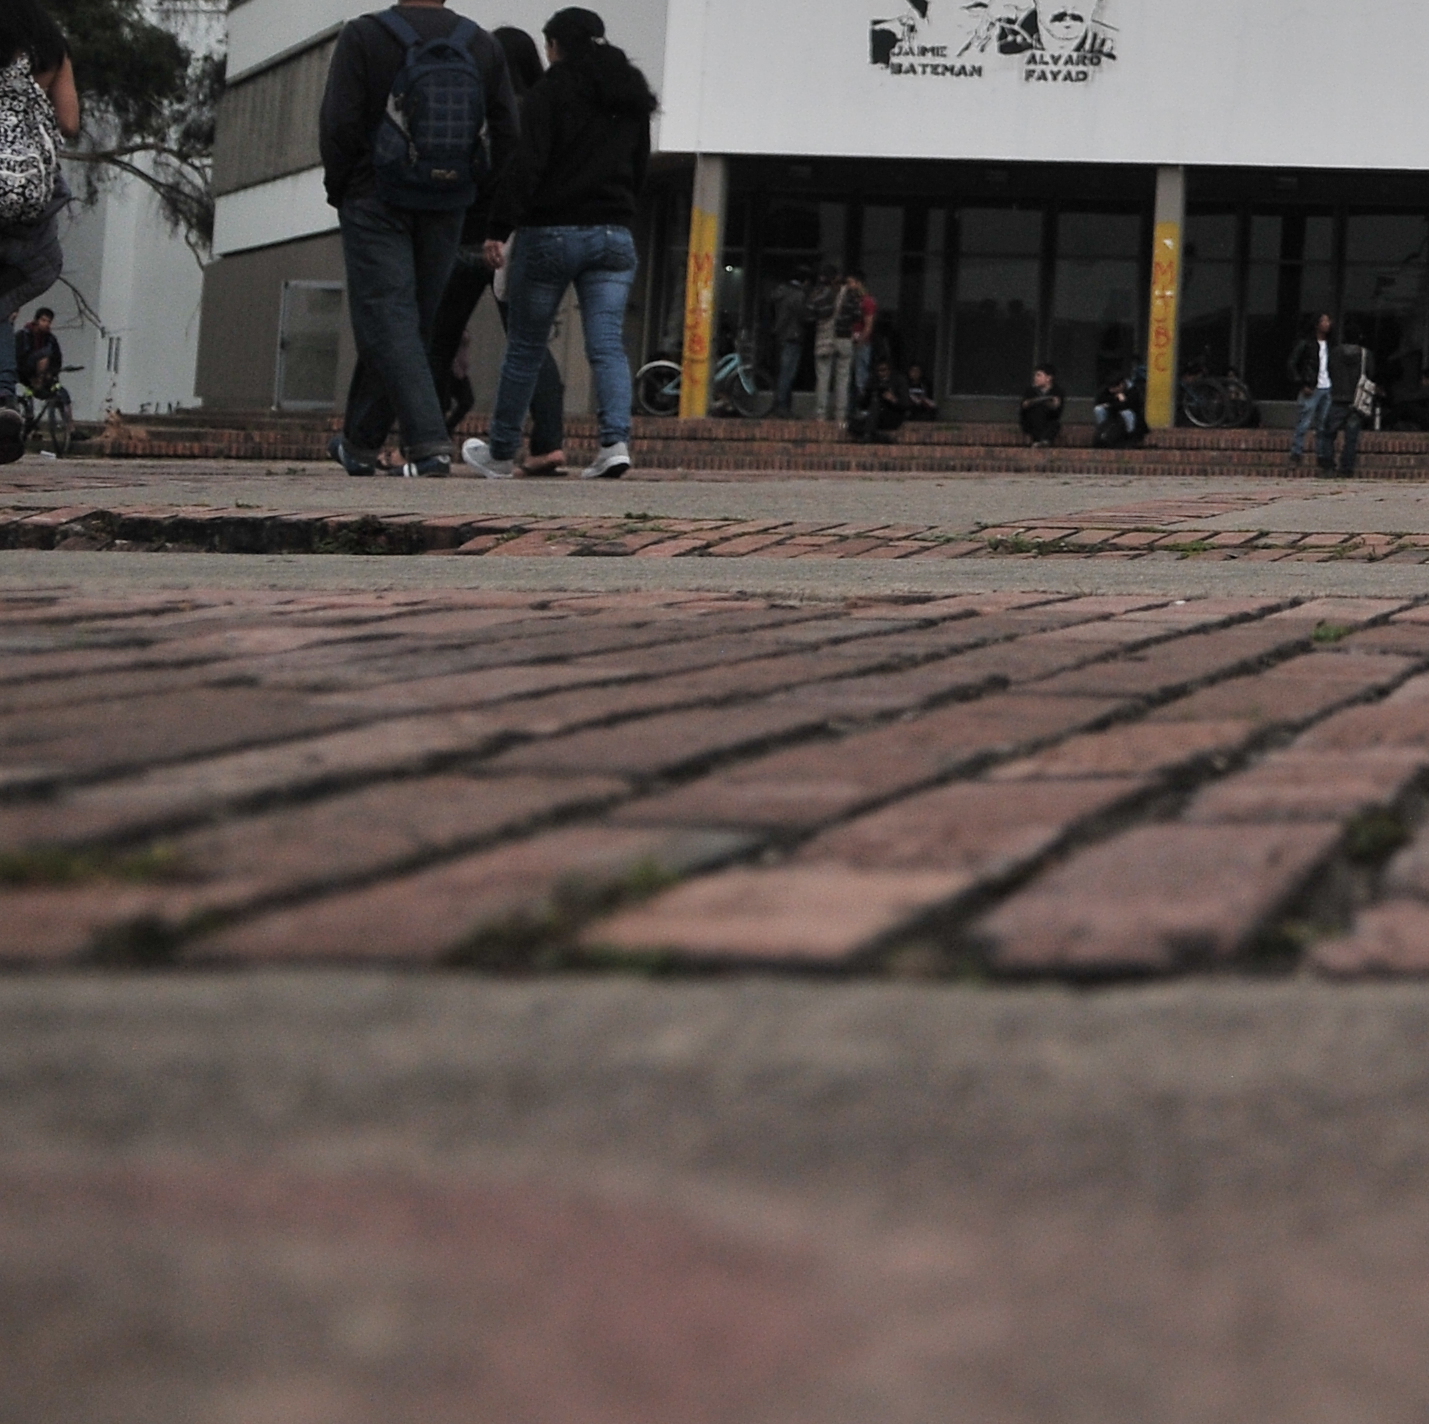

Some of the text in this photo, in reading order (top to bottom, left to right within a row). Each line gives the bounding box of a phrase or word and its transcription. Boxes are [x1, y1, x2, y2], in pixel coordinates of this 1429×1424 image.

[890, 45, 948, 58] JAIME
[1025, 52, 1102, 67] ALVARO
[890, 61, 983, 78] BATEMAN
[1024, 68, 1088, 83] FAYAD
